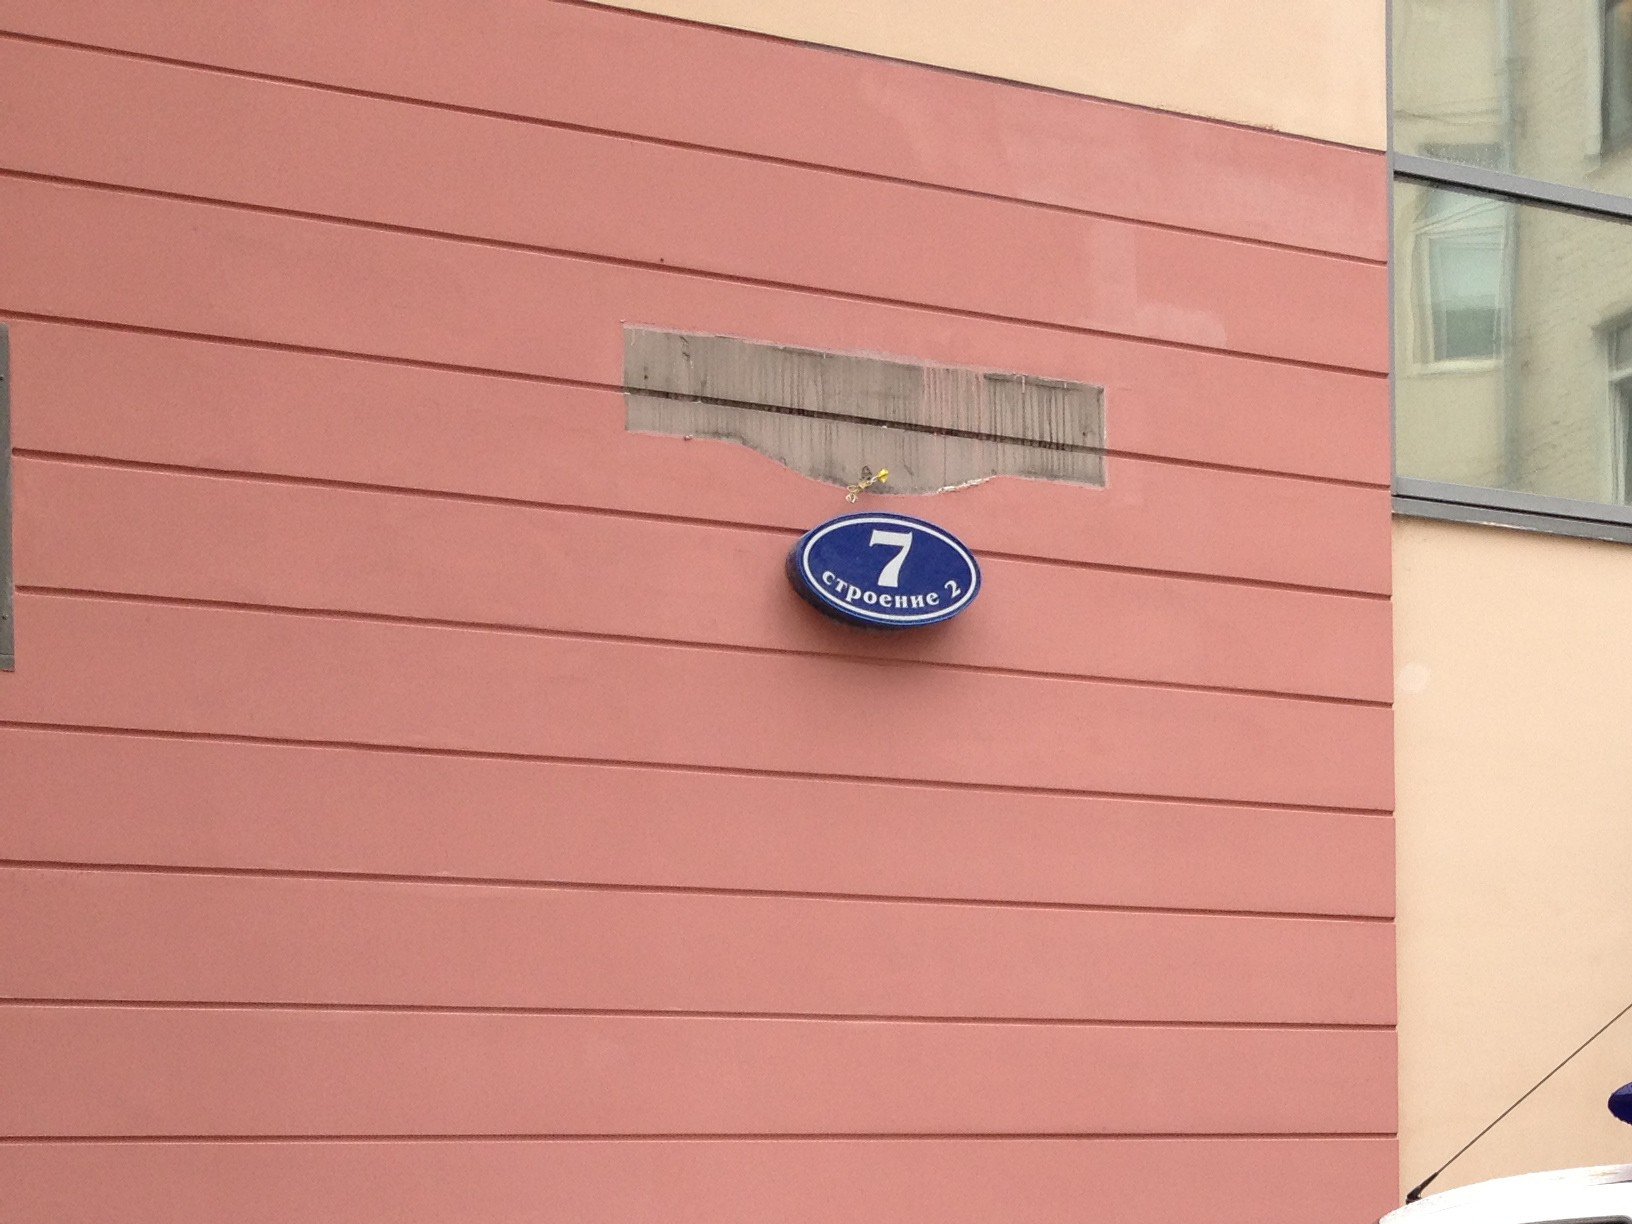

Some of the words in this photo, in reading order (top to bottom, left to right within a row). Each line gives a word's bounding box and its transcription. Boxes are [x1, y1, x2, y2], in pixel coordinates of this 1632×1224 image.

[869, 529, 913, 588] 7
[821, 570, 940, 609] строение
[944, 579, 961, 598] 2
